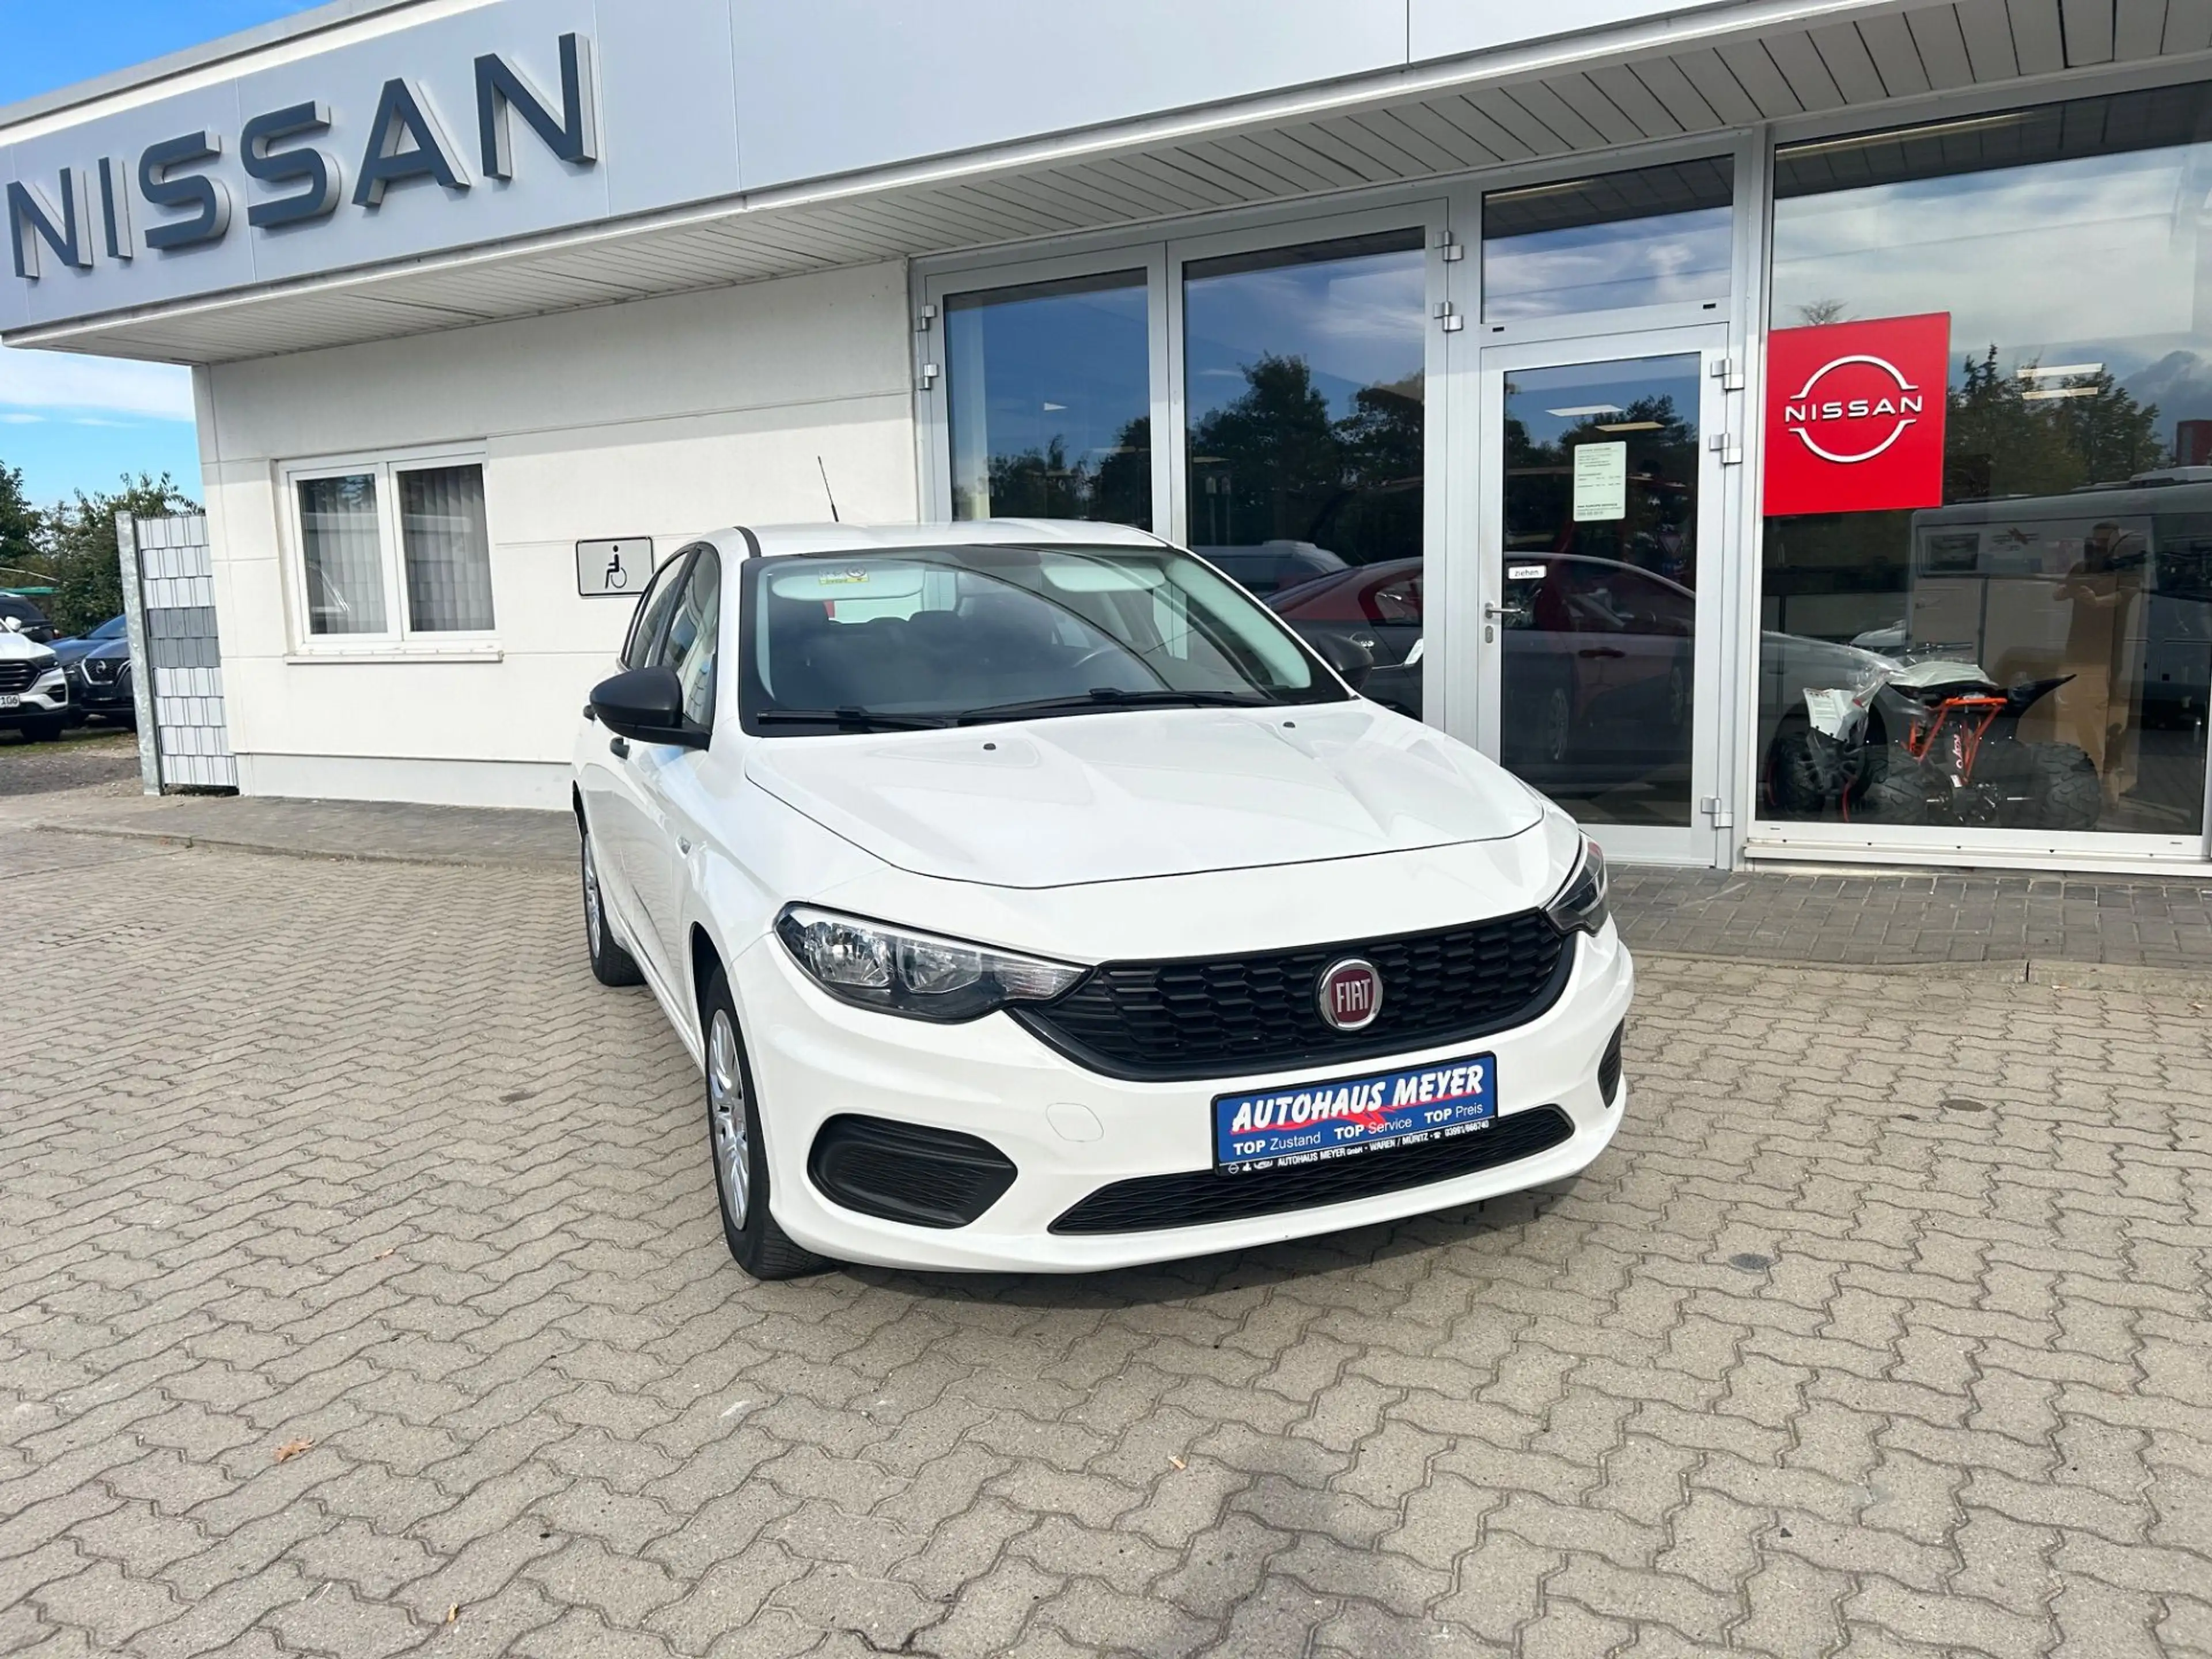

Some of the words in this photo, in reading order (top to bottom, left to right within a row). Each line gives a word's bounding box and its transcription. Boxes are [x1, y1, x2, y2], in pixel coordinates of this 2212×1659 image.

[7, 32, 597, 279] NISSAN
[1784, 395, 1923, 422] NISSAN
[1336, 979, 1370, 1012] FIAT
[1231, 1081, 1387, 1132] AUTOHAUS
[1392, 1064, 1484, 1108] MEYER
[1233, 1140, 1266, 1156] TOP
[1270, 1132, 1321, 1150] Zustand
[1334, 1124, 1365, 1140] TOP
[1368, 1118, 1412, 1135] Service
[1424, 1108, 1452, 1124] TOP
[1455, 1103, 1483, 1118] Preis
[1277, 1152, 1318, 1167] AUTOHAUS
[1320, 1147, 1346, 1160] MEYER
[1369, 1139, 1396, 1152] WAREN
